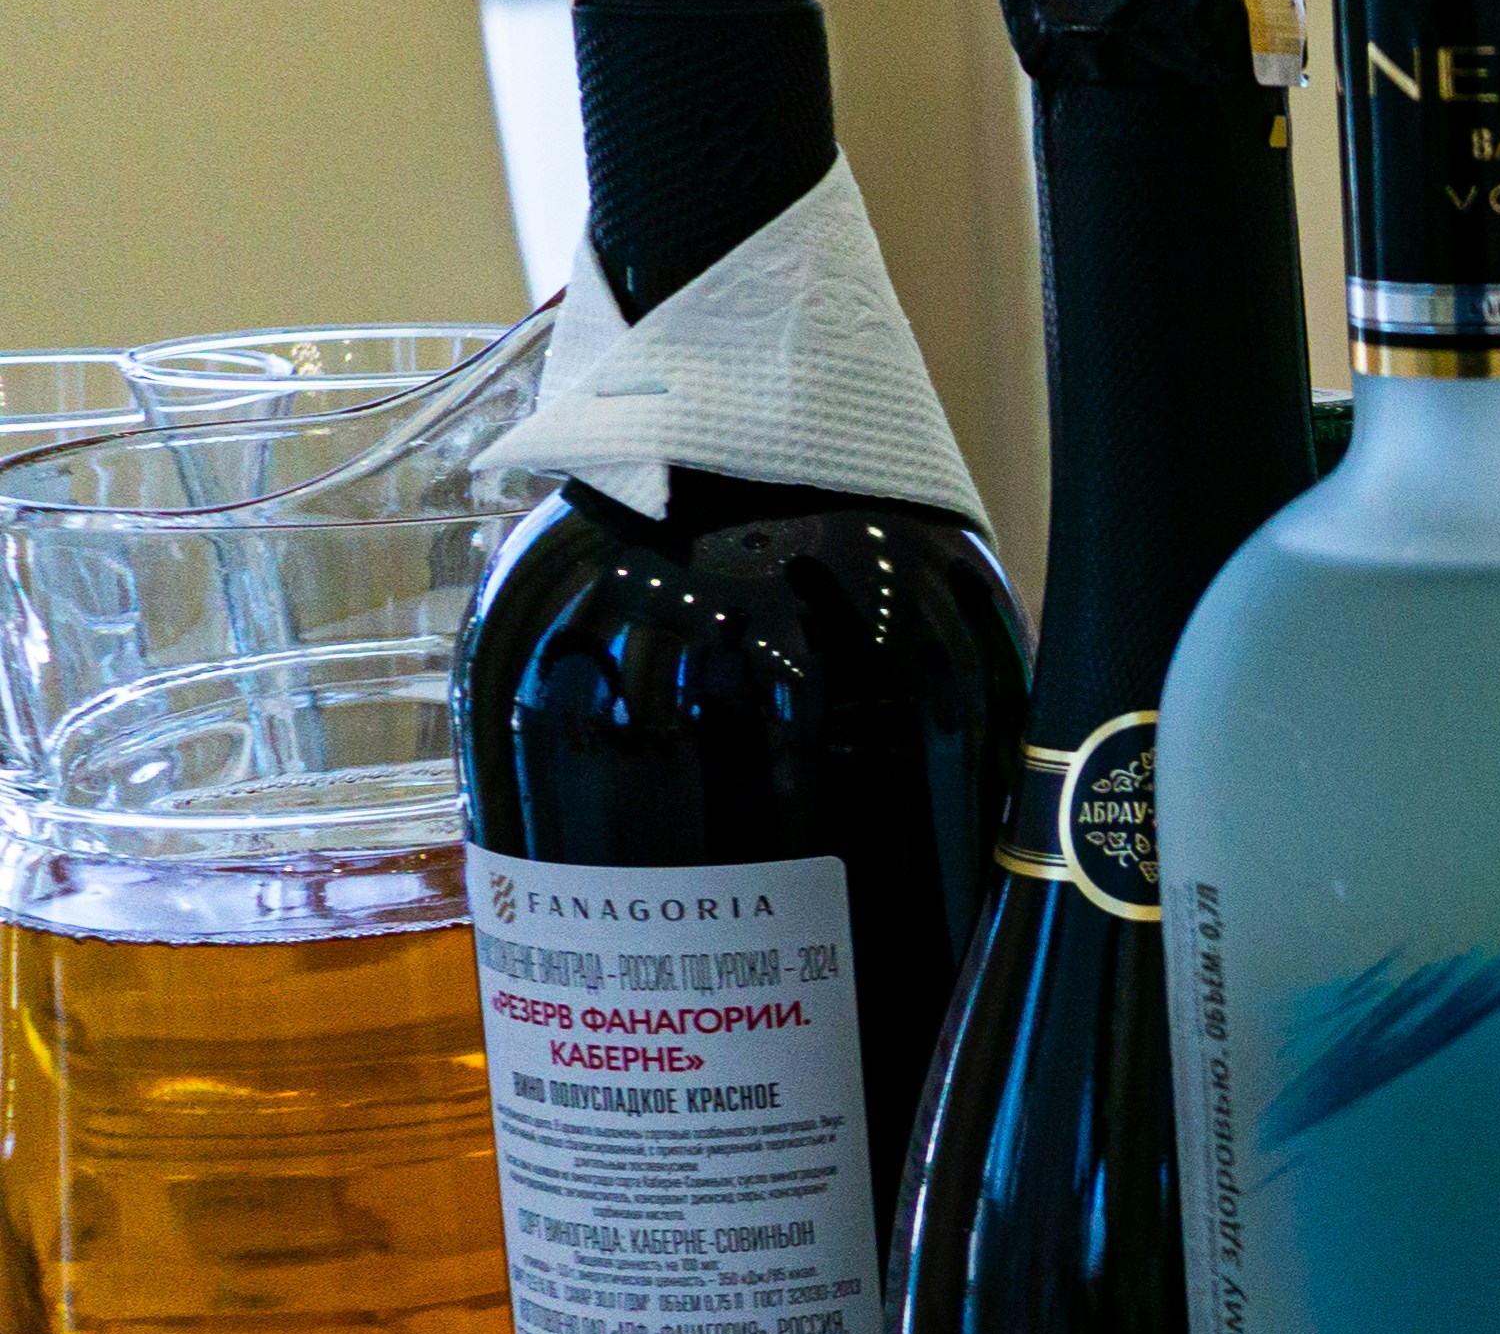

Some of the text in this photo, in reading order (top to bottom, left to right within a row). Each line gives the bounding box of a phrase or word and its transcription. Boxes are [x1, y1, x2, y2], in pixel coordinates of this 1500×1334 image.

[527, 890, 774, 923] FANAGORIA
[681, 953, 714, 997] ГОД
[714, 947, 783, 992] УРОЖАЯ
[798, 942, 838, 984] 2024
[491, 988, 812, 1035] «РЕЗЕРВ ФАНАГОРИИ.
[550, 1038, 705, 1074] КАБЕРНЕ»
[511, 1070, 782, 1118] ВИНО ПОЛУСЛАДКОЕ КРАСНОЕ
[629, 1219, 817, 1256] КАБЕРНЕ-СОВИНЬОН
